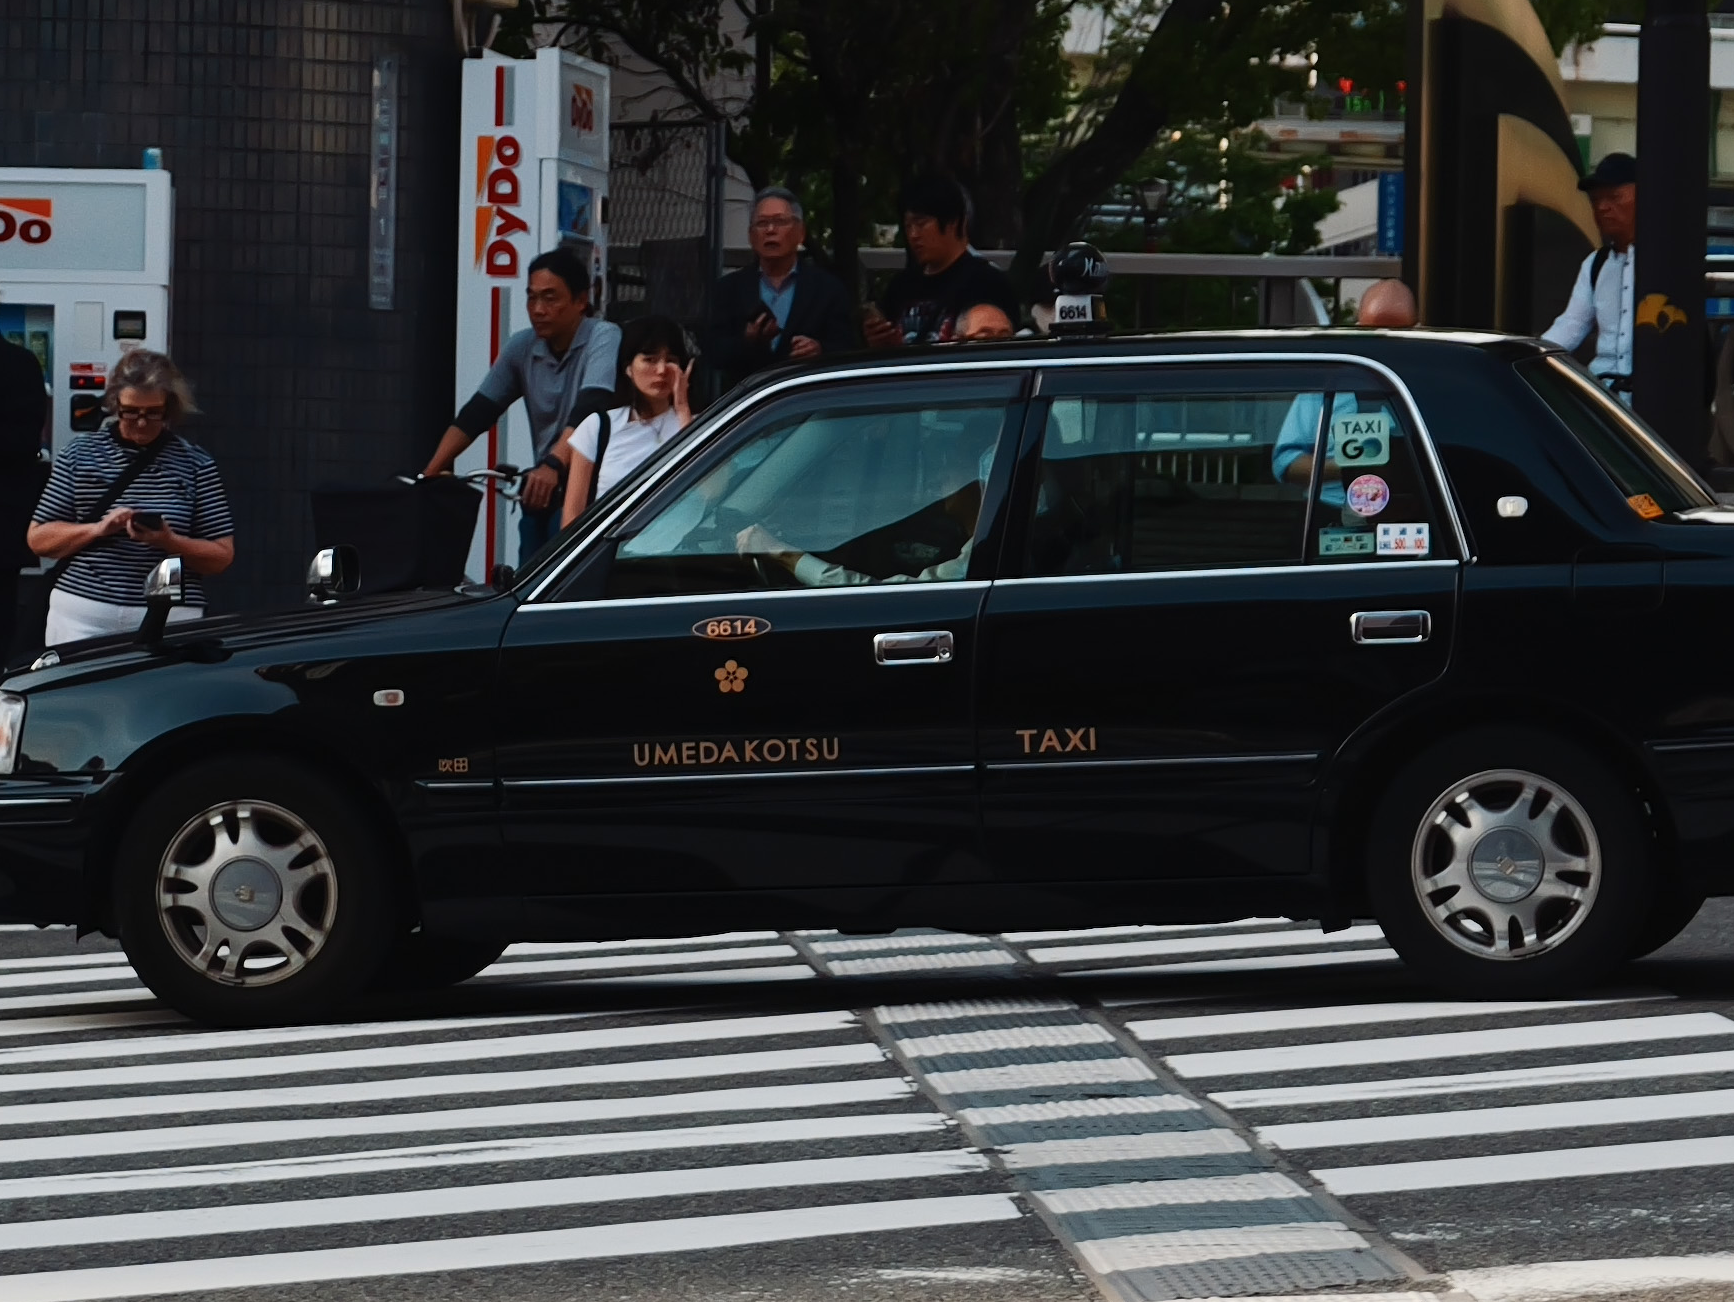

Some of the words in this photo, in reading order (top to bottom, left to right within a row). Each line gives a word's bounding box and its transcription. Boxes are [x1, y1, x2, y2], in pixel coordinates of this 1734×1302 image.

[486, 135, 529, 277] DyDo
[1060, 304, 1086, 320] 6614
[1341, 420, 1382, 434] TAXI
[1342, 437, 1383, 460] GO
[706, 618, 758, 637] 6614
[1015, 727, 1099, 754] TAXI
[632, 737, 841, 767] UMEDAKOTSU
[437, 757, 469, 774] 吹田
